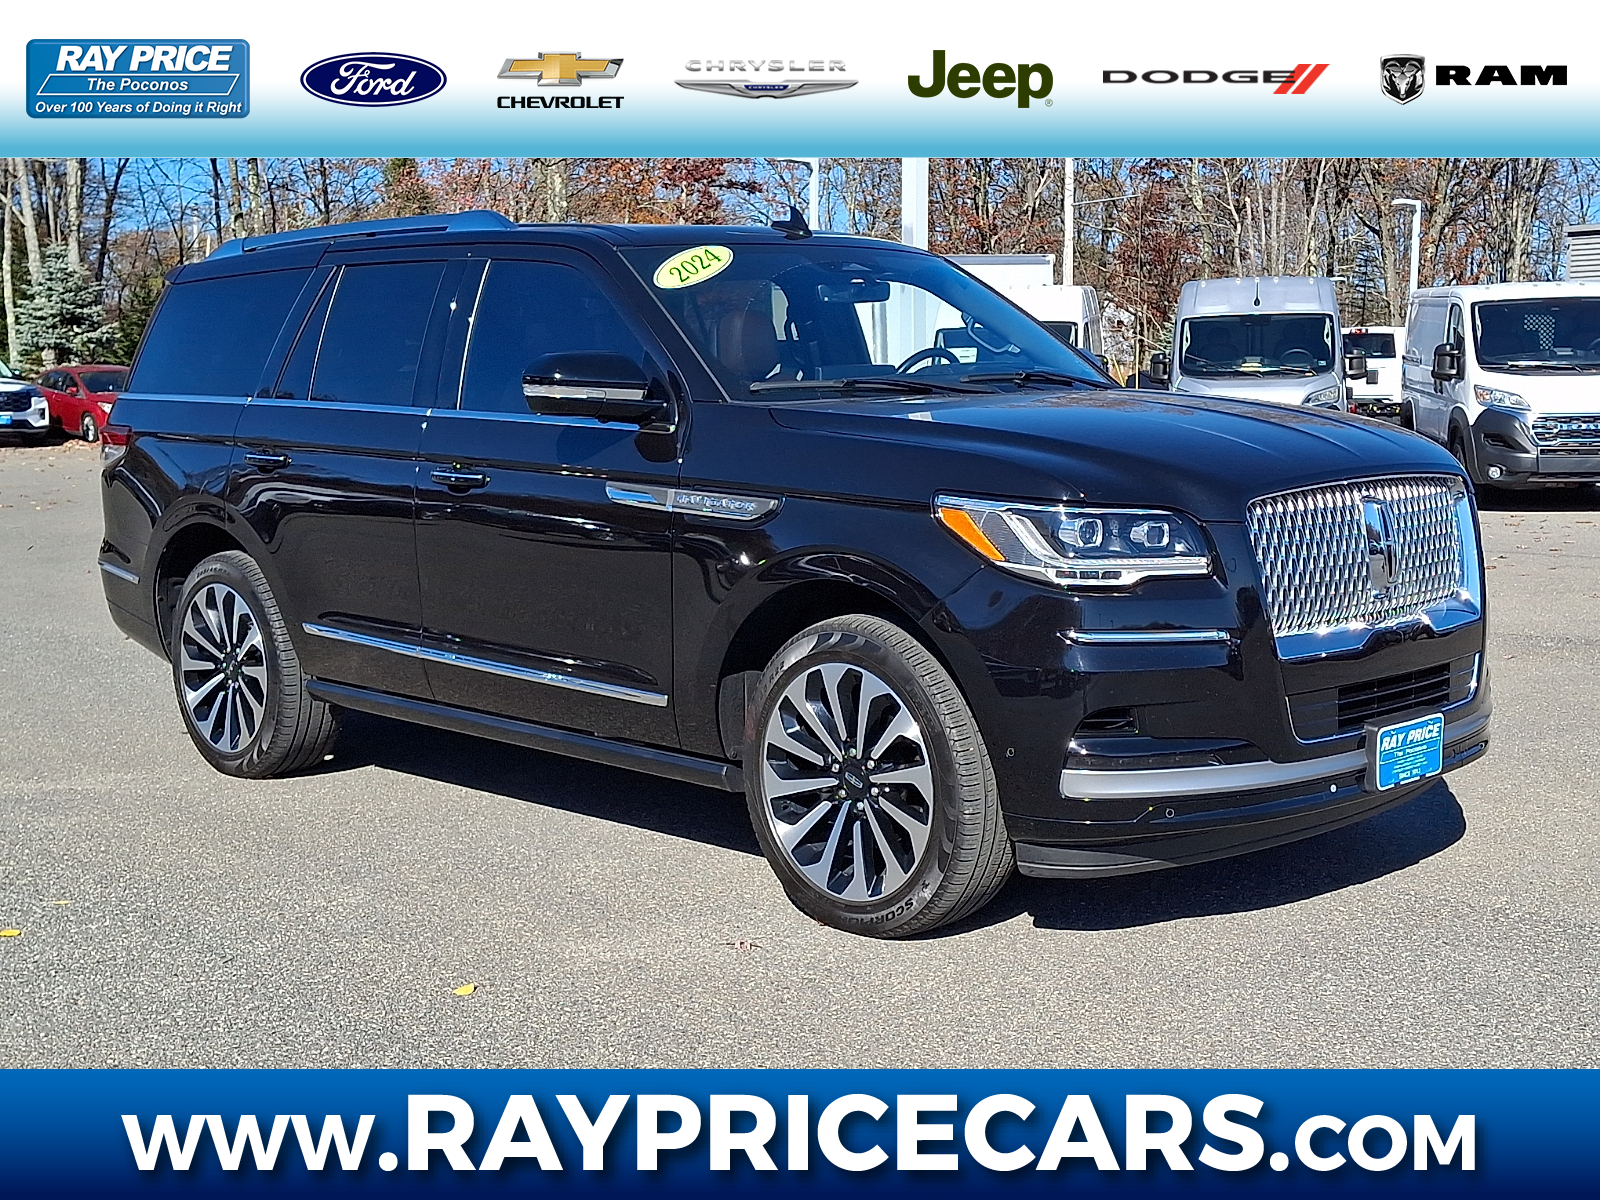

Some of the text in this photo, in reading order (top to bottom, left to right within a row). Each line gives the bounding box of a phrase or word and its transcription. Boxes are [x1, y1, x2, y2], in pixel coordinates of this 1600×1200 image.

[669, 249, 722, 283] 2024
[1381, 722, 1441, 751] RAY PRICE
